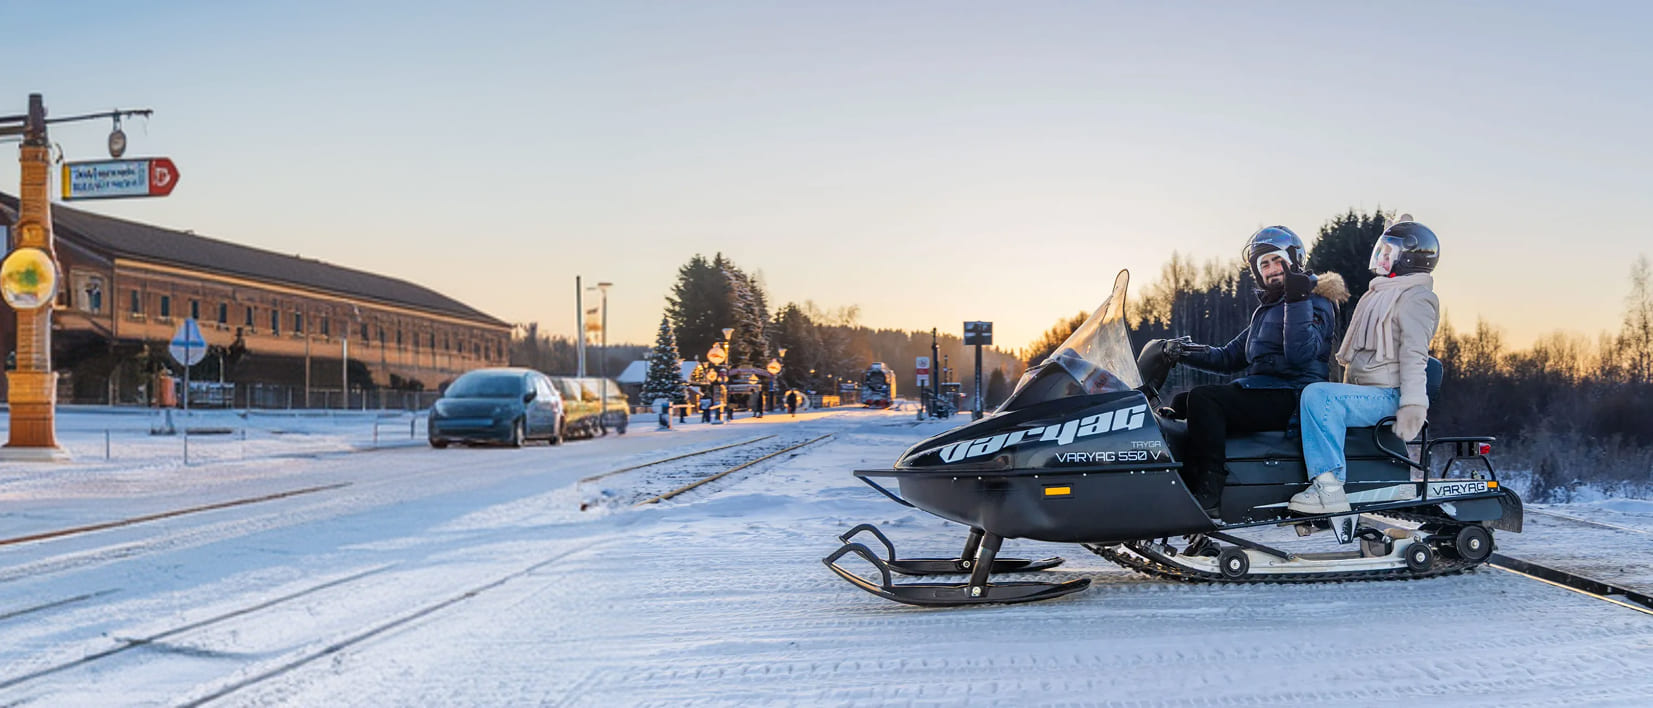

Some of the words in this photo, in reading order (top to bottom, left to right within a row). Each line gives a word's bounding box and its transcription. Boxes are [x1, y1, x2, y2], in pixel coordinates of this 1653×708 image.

[1131, 440, 1162, 448] TAYGA
[1055, 451, 1116, 463] VARYAG
[1118, 450, 1147, 461] 550
[1150, 450, 1162, 460] V
[1433, 482, 1485, 496] VARYAG
